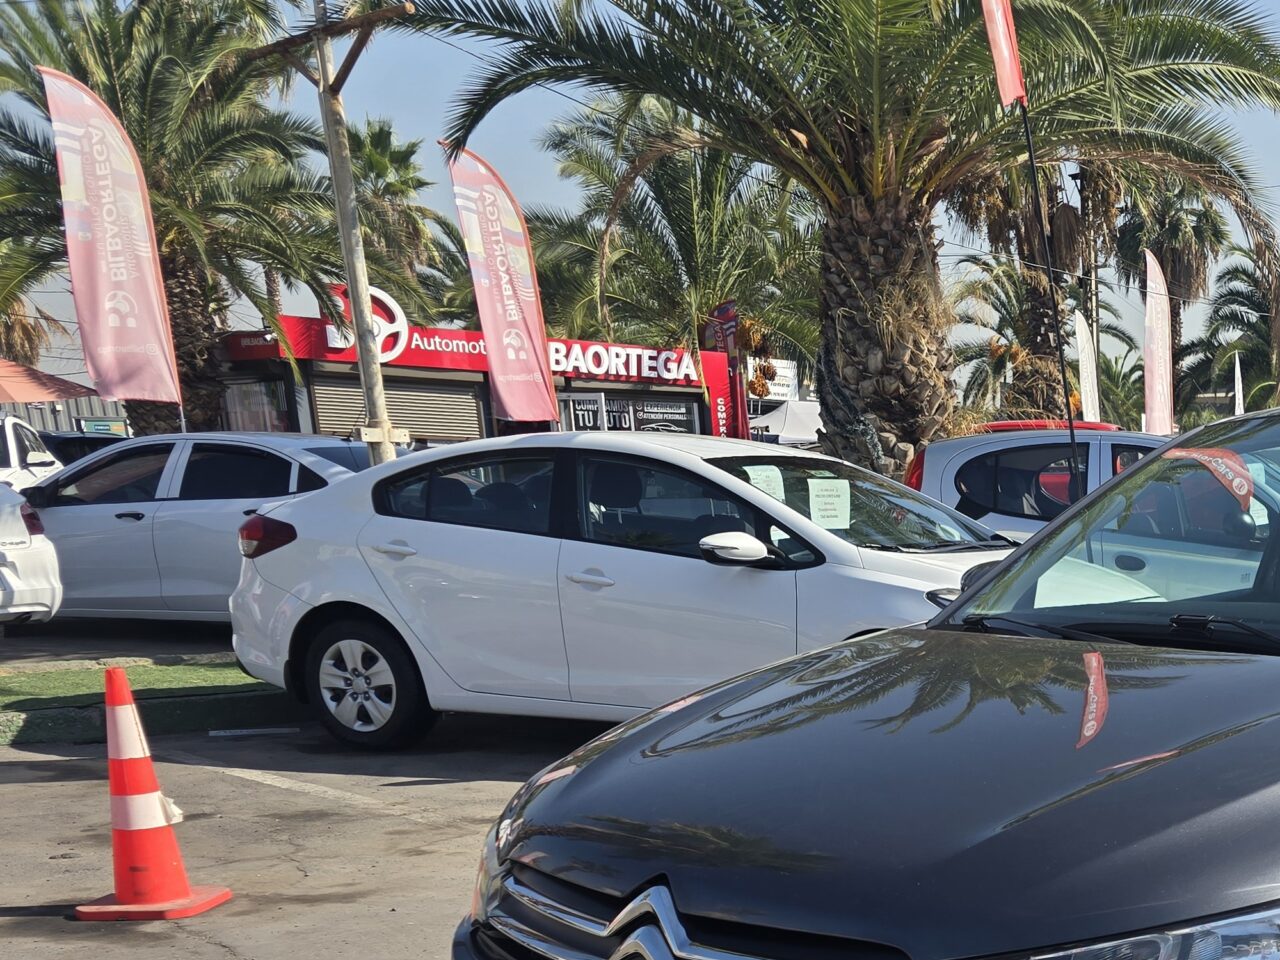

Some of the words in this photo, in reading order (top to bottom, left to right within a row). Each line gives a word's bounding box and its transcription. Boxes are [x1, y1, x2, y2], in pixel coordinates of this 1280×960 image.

[410, 332, 487, 355] Automot
[550, 341, 699, 381] BAORTEGA
[575, 400, 628, 412] COMPAMOS
[576, 411, 594, 427] TU
[597, 412, 630, 428] UTO
